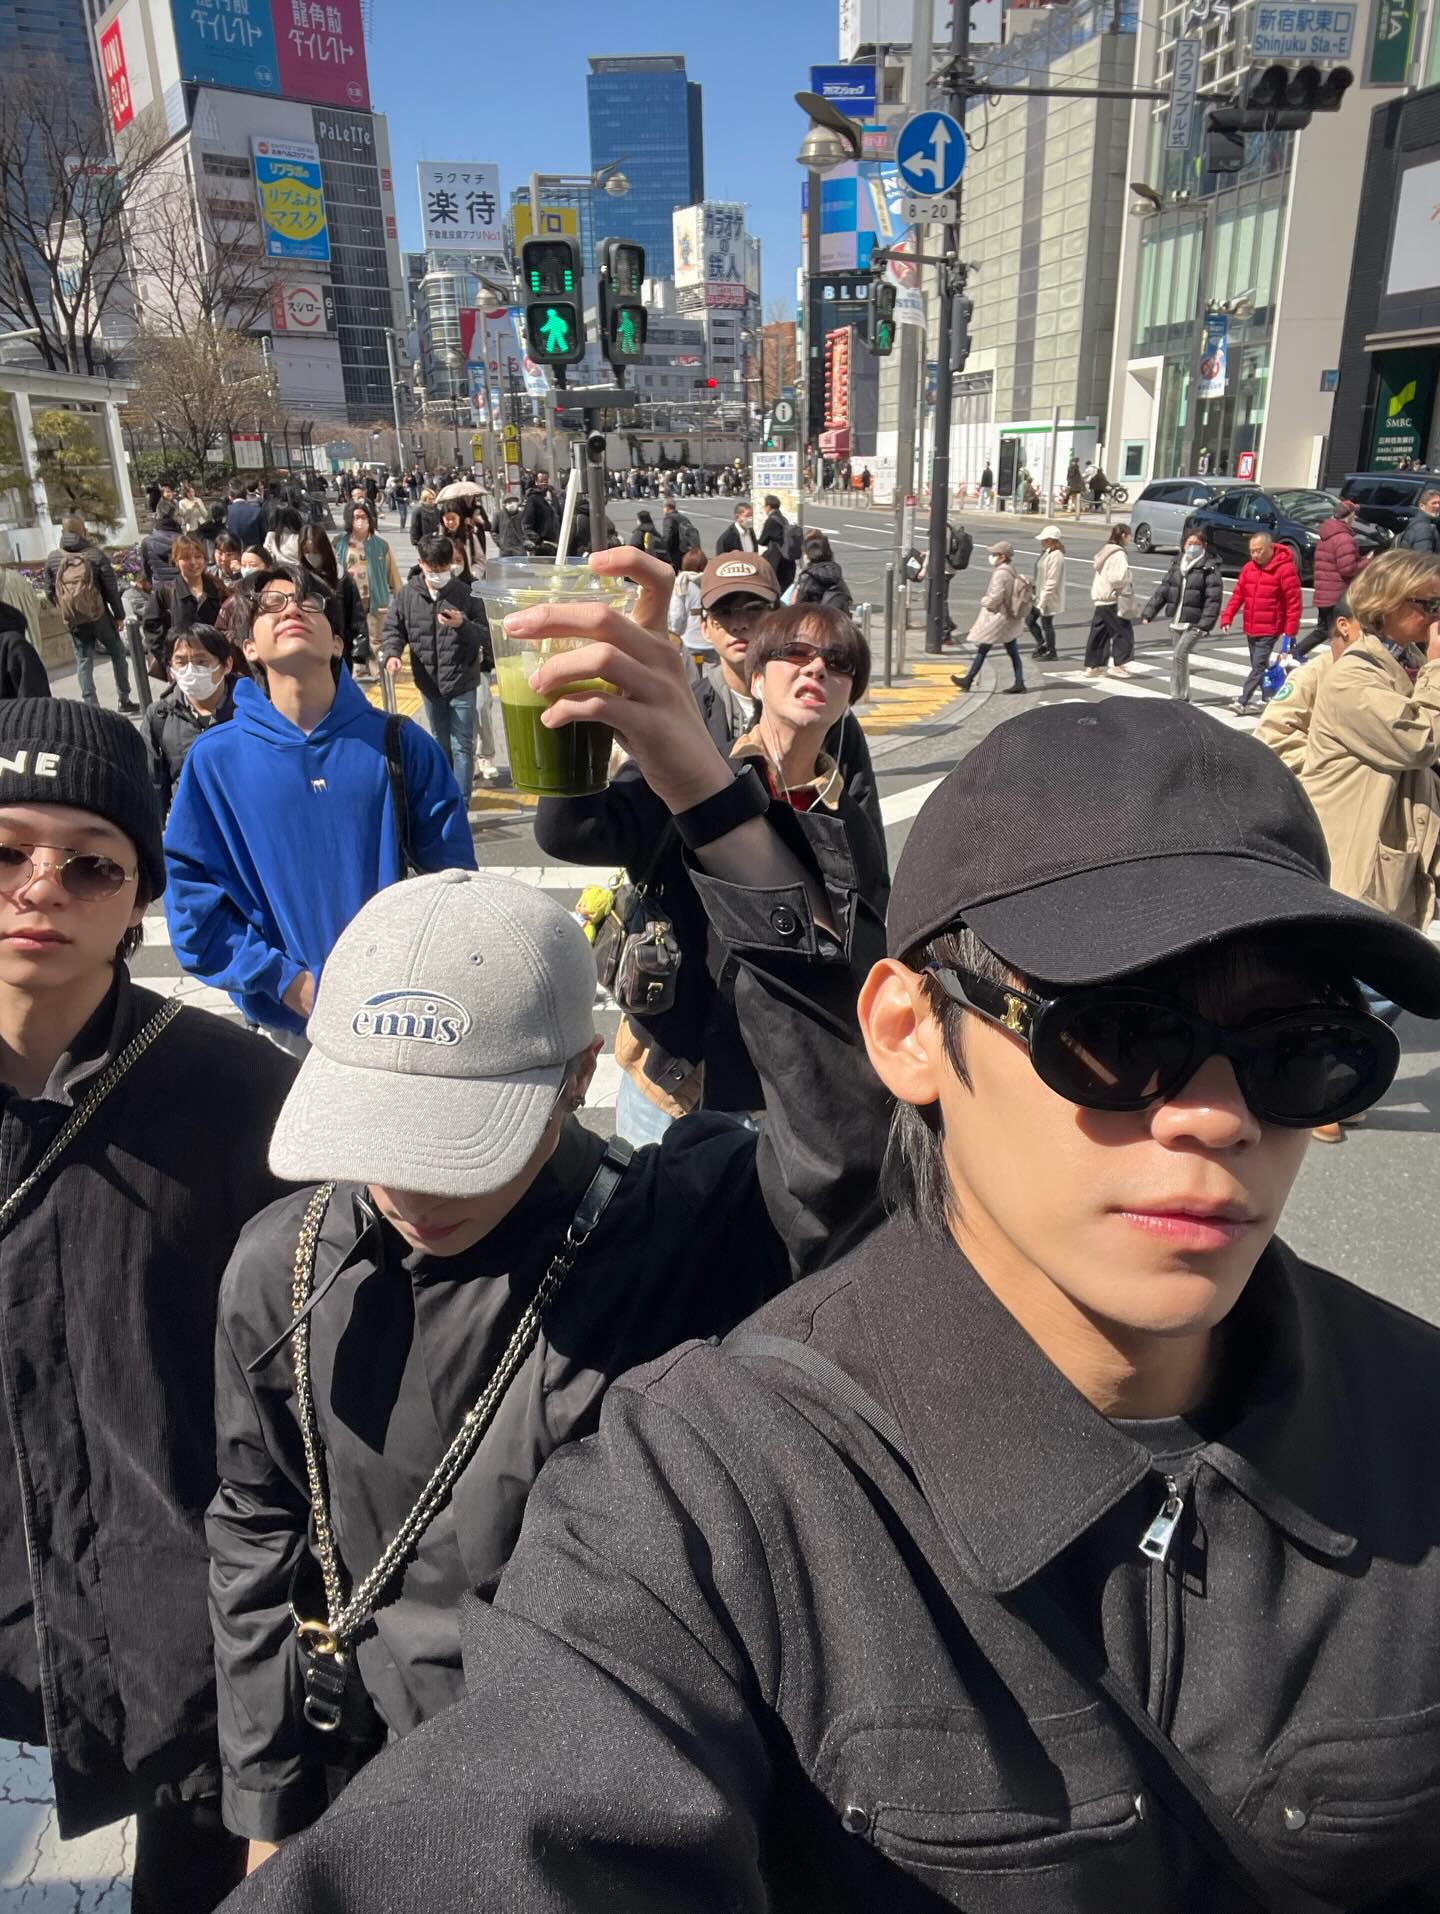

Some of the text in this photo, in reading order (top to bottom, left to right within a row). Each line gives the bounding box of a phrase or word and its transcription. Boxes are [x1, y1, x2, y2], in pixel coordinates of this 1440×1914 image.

[1258, 9, 1352, 33] 新宿駅東口
[103, 34, 122, 78] UNI
[1255, 34, 1307, 55] Shinjuku
[1171, 43, 1194, 146] スクランブル式
[433, 172, 485, 184] ラクマチ
[427, 188, 497, 225] 楽待
[287, 302, 322, 313] スシロー
[1385, 418, 1413, 428] SMBC
[352, 1001, 462, 1046] emis
